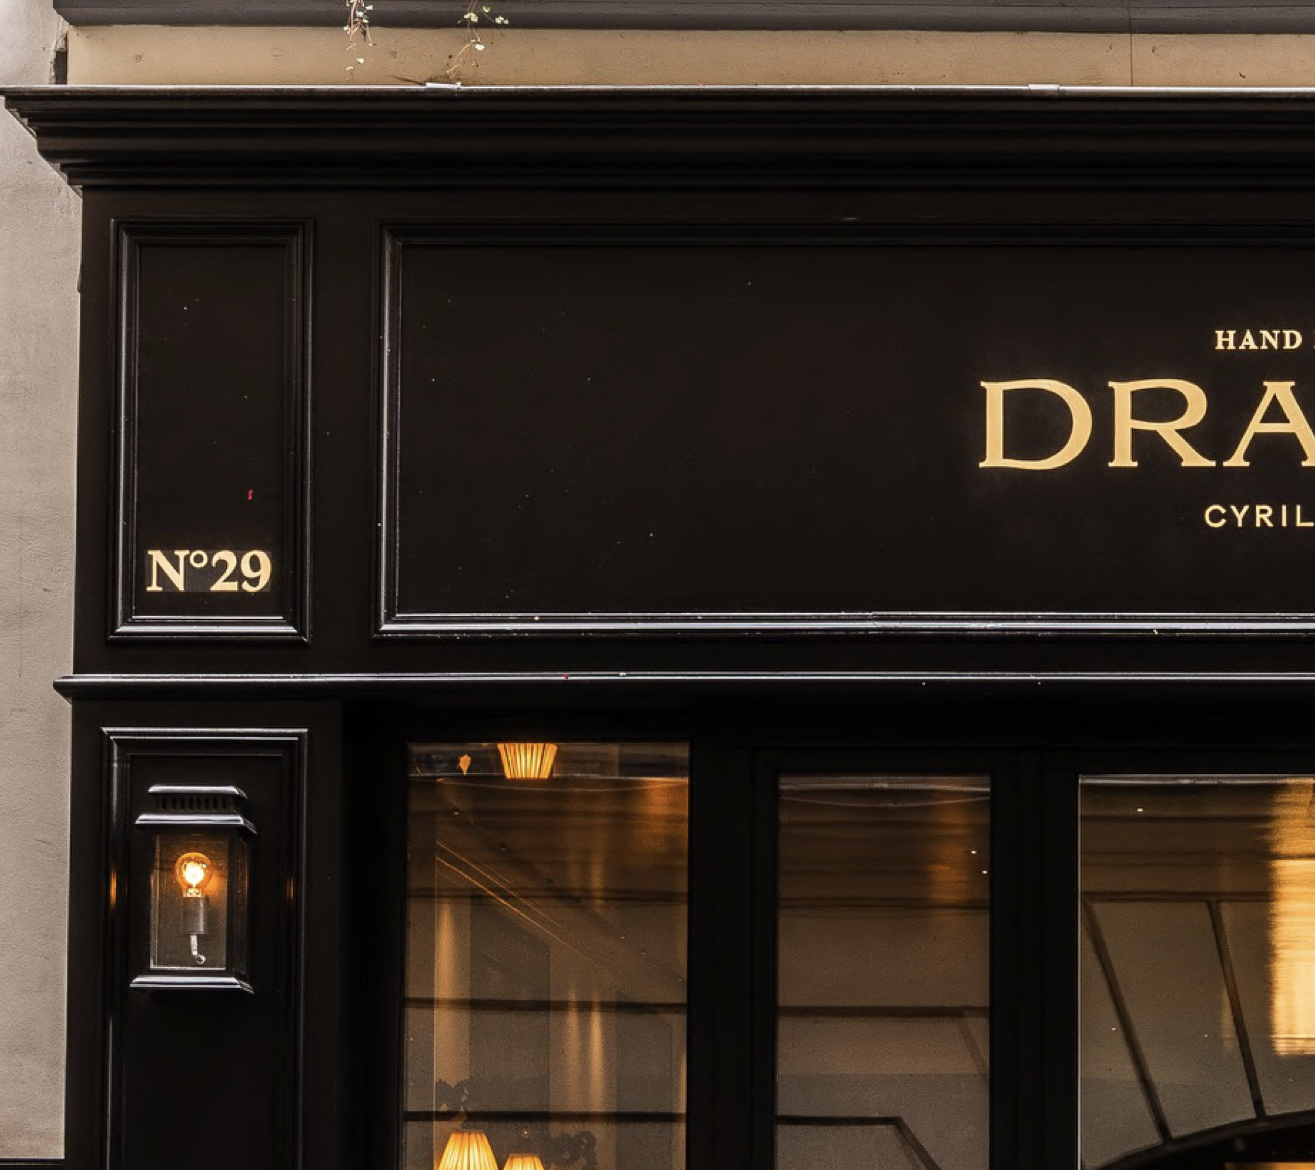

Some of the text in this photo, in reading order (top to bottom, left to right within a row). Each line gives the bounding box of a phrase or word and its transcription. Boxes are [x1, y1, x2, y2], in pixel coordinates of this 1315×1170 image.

[1214, 329, 1303, 350] HAND
[1204, 504, 1315, 528] CYRIL
[146, 549, 272, 592] N°29
